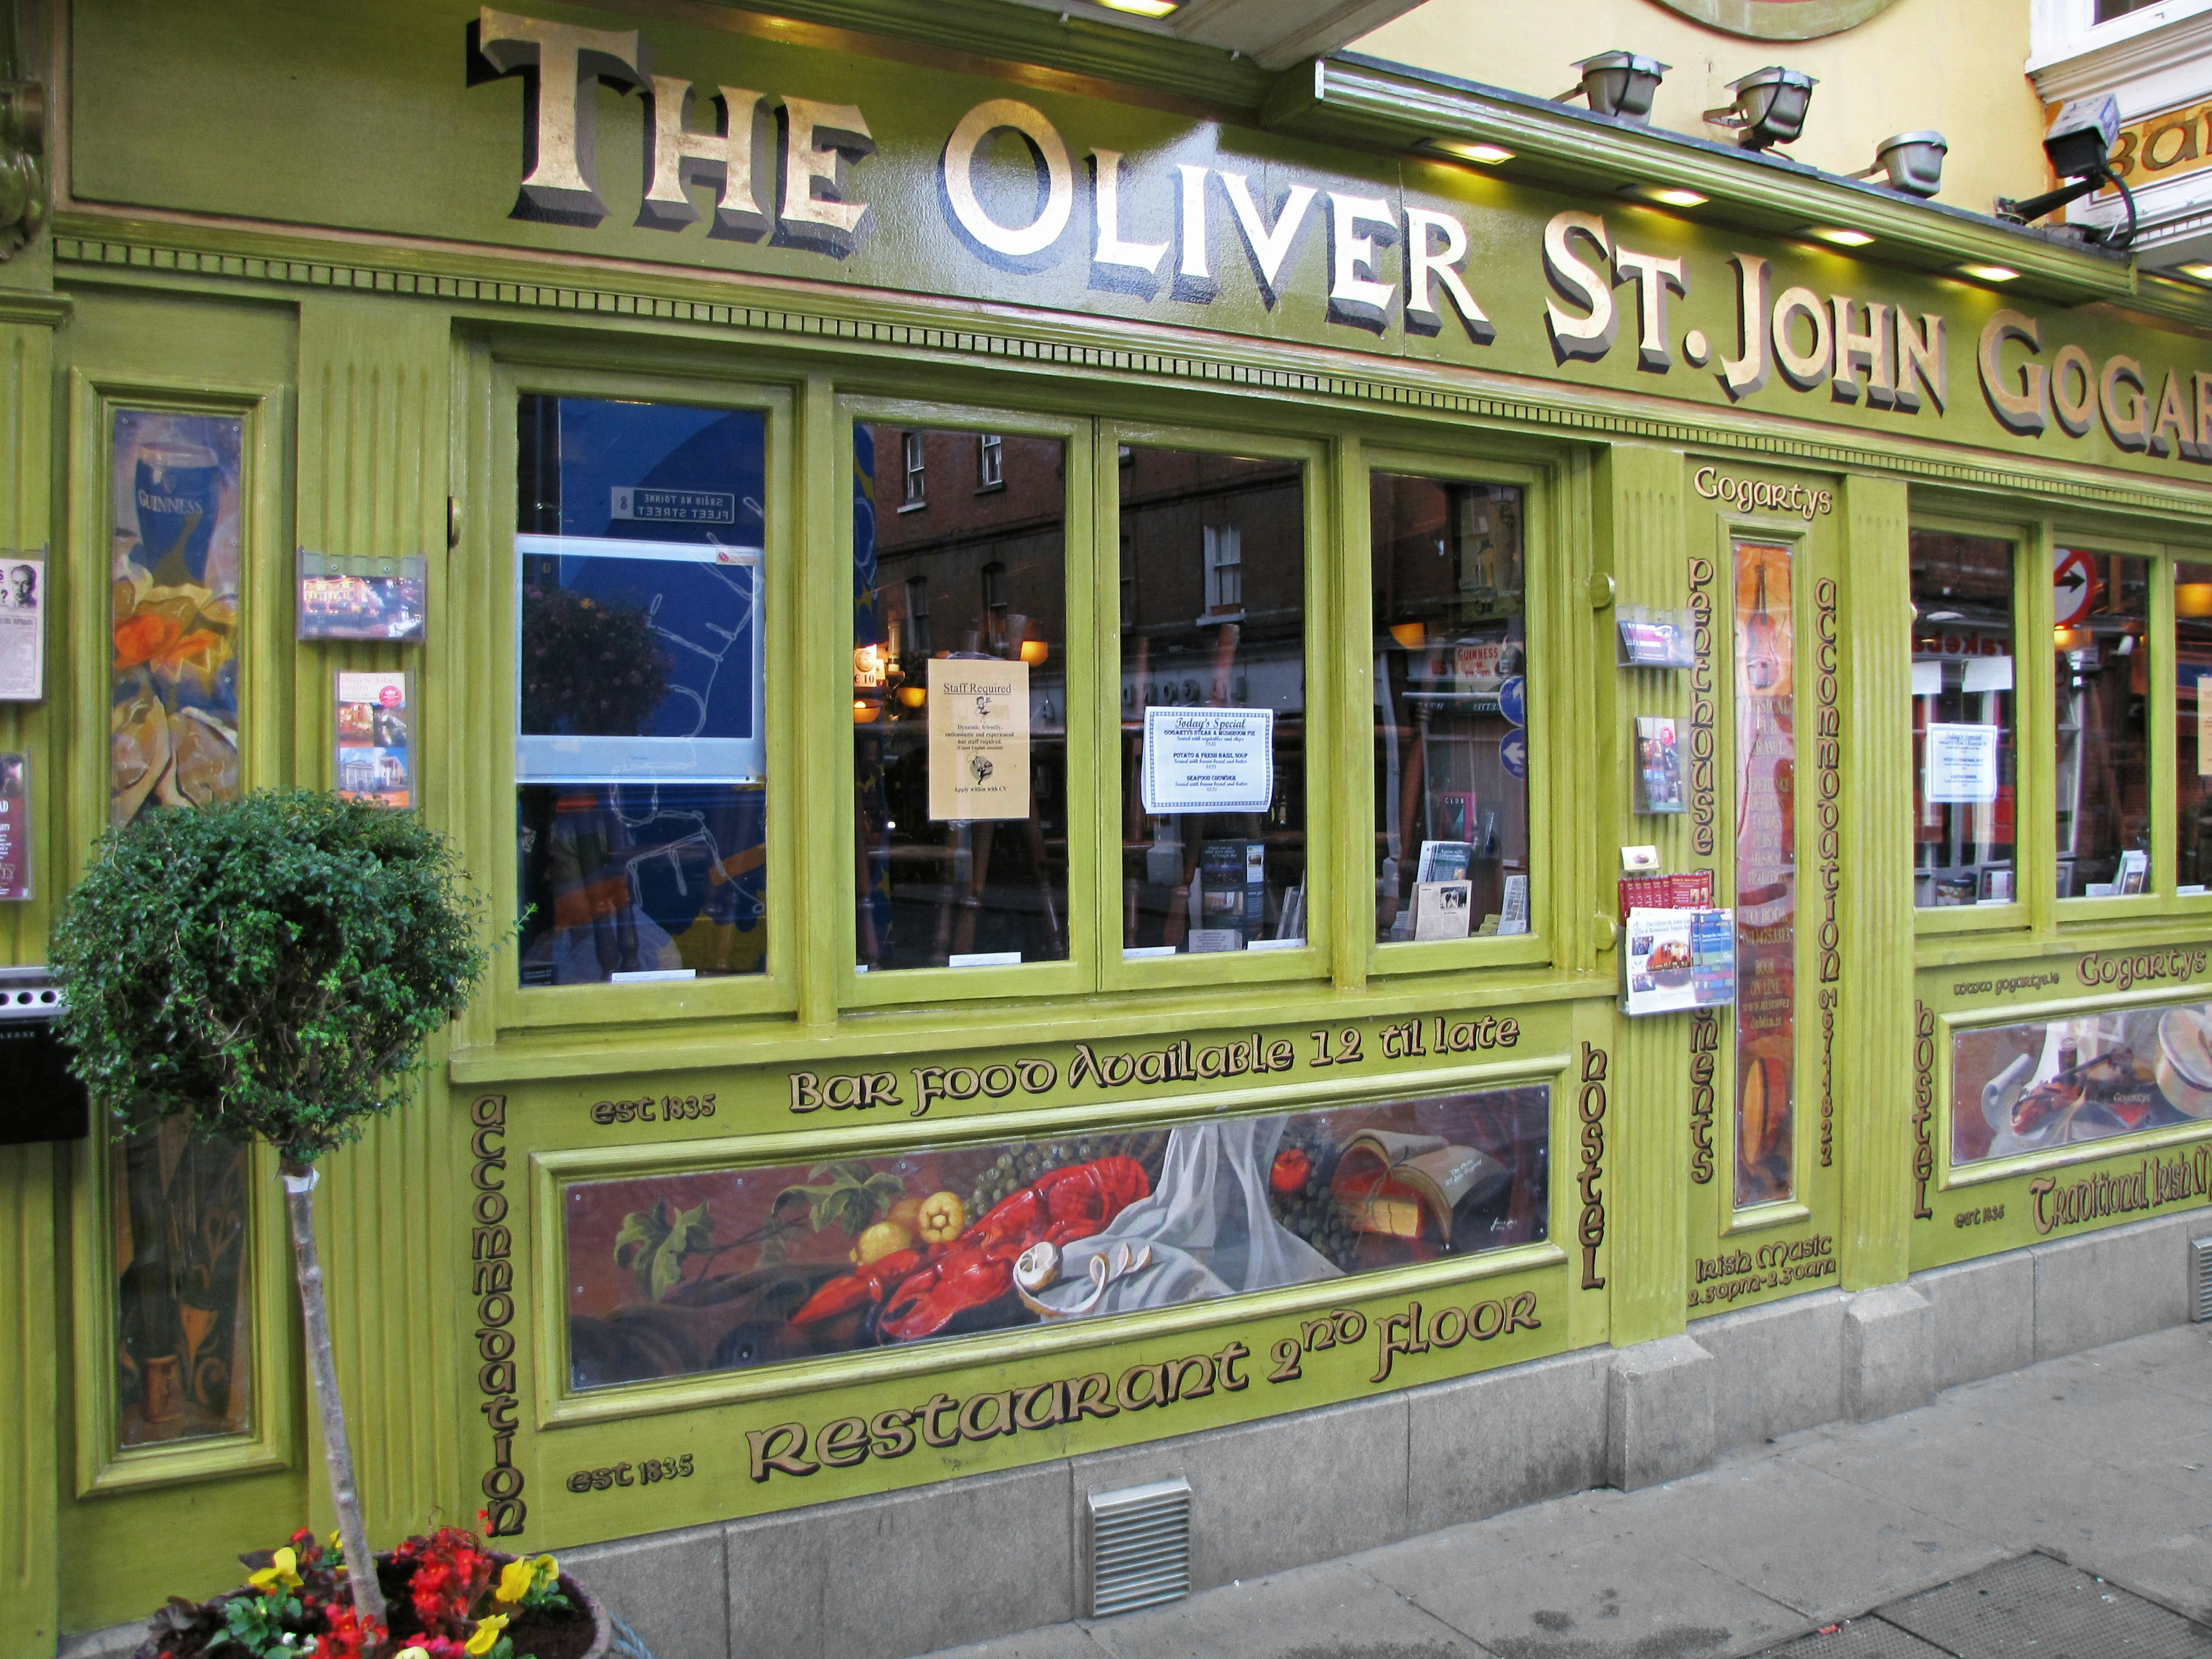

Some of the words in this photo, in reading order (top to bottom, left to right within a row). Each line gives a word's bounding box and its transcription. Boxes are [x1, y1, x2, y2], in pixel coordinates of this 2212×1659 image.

[466, 5, 877, 261] THE
[935, 98, 1498, 347] OLIVER
[1541, 209, 1710, 374] ST.
[1715, 251, 1947, 417] JOHN
[139, 488, 203, 514] GUINNESS
[1694, 465, 1832, 520] Gogartys
[1457, 647, 1498, 661] GUINNESS
[943, 683, 968, 694] Staff
[969, 683, 1012, 695] Required
[1687, 558, 1715, 856] penthouse
[1175, 717, 1210, 731] Today's
[1213, 718, 1246, 731] Special
[1814, 577, 1839, 982] accommodation
[2077, 949, 2206, 990] Gogartys
[788, 1071, 903, 1113] Bar
[910, 1058, 1058, 1117] Food
[1069, 1033, 1294, 1089] Available
[1309, 1028, 1364, 1067] 12
[1380, 1018, 1426, 1059] til
[1433, 1015, 1520, 1053] late
[590, 1098, 656, 1126] est
[661, 1093, 717, 1122] 1835
[1954, 1208, 1979, 1228] est
[2029, 1159, 2149, 1235] Traditional
[2150, 1151, 2191, 1207] Irish
[1695, 1248, 1752, 1284] Irish
[1756, 1233, 1832, 1270] Music
[471, 1094, 528, 1537] accommodation
[744, 1341, 1250, 1484] Restaurant
[1267, 1309, 1368, 1383] 2nd
[1369, 1291, 1542, 1383] Floor
[566, 1463, 635, 1494] est
[638, 1453, 695, 1486] 1835
